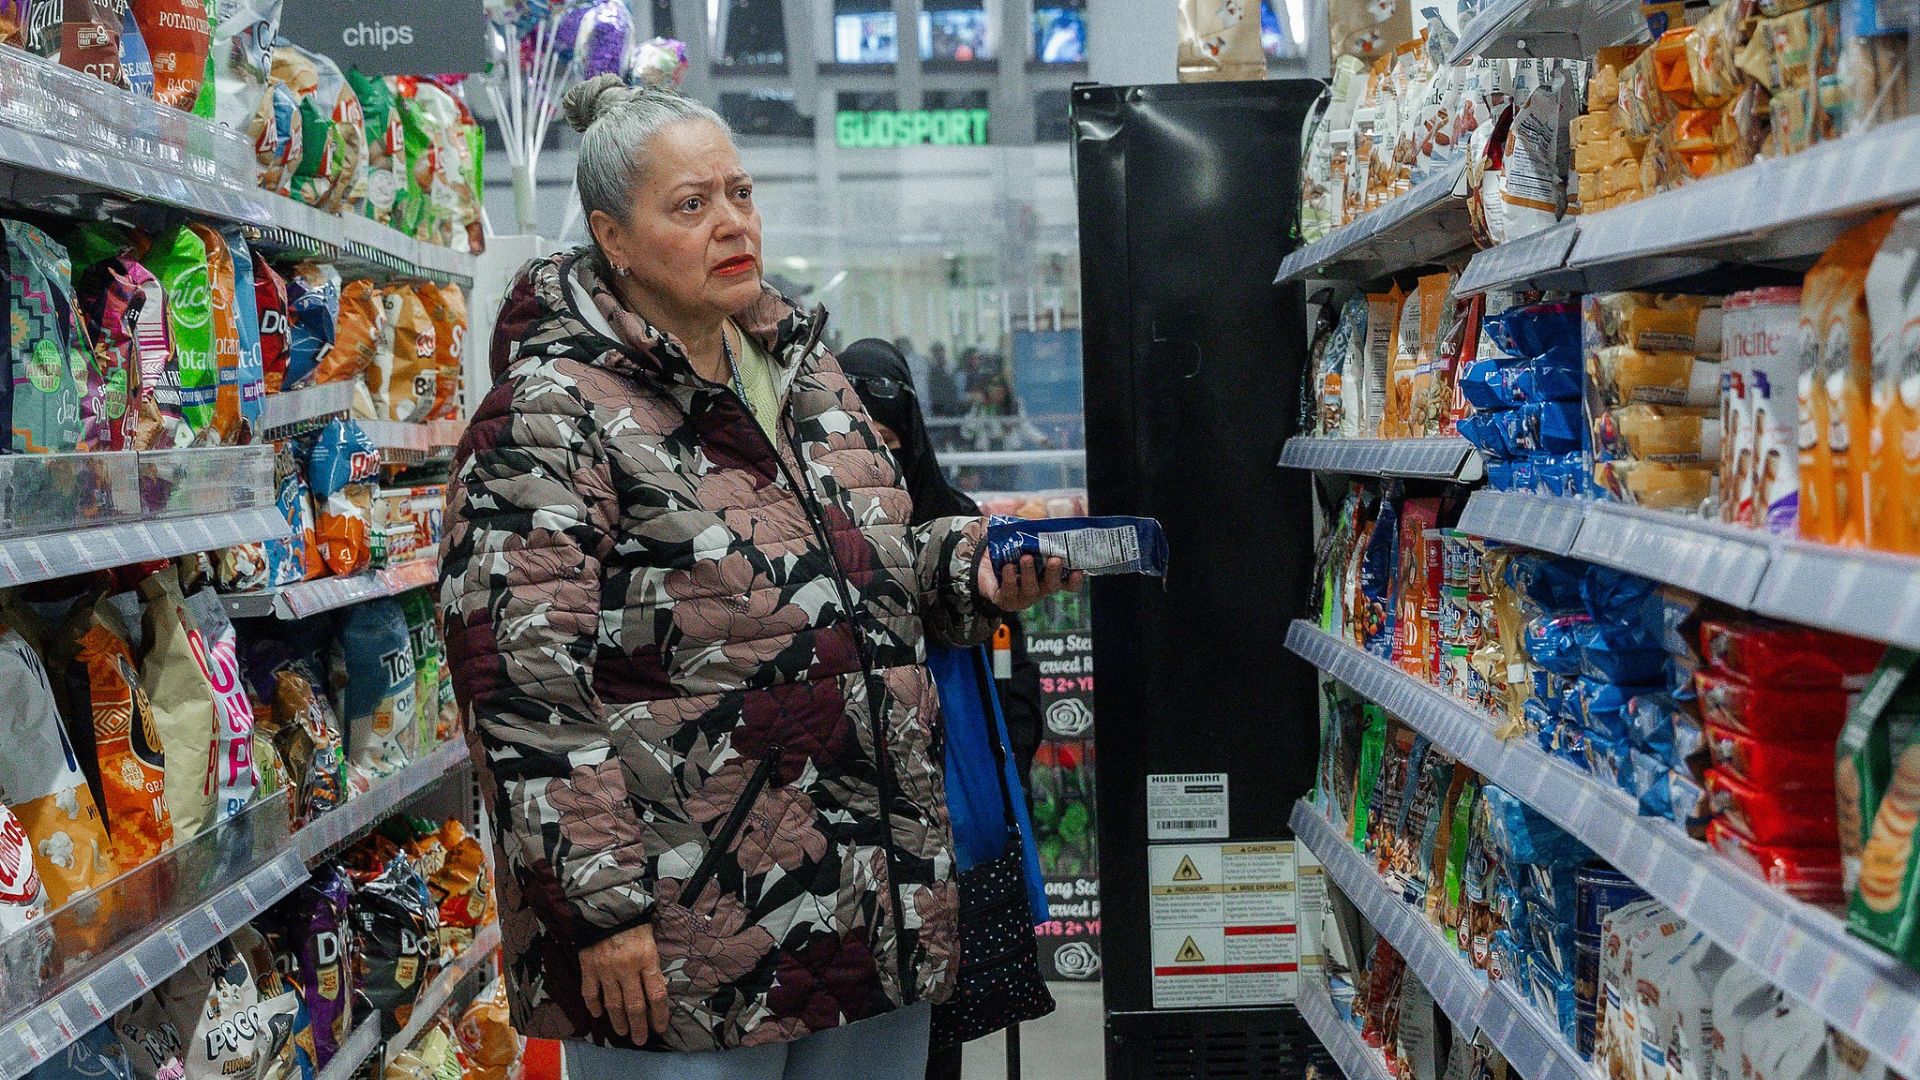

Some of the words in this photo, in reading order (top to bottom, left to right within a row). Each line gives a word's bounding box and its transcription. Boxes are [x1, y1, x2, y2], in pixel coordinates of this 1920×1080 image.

[159, 11, 196, 31] POTATO
[343, 21, 414, 50] chips
[1027, 635, 1064, 656] Long
